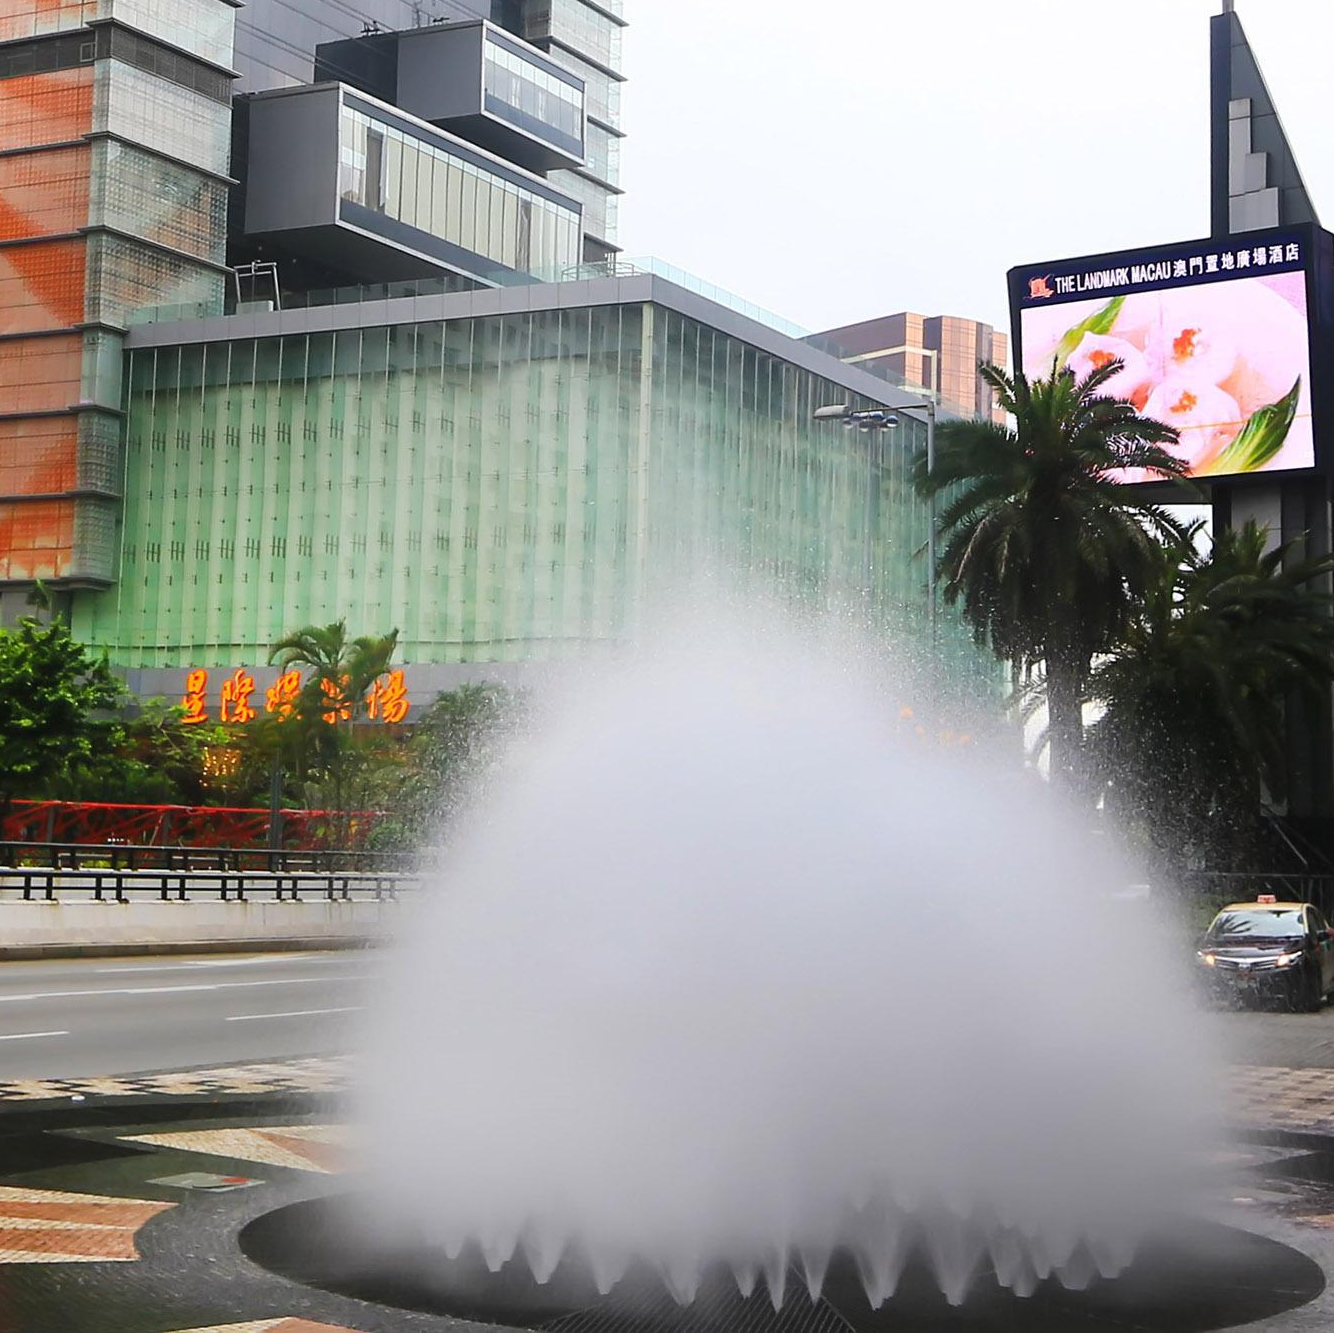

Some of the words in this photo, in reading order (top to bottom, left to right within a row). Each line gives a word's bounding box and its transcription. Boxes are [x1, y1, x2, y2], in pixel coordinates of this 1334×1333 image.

[1055, 274, 1076, 294] THE
[1076, 267, 1129, 292] LANDMARK
[1131, 261, 1171, 283] MACAU
[1173, 242, 1299, 277] 澳門置地廣場酒店
